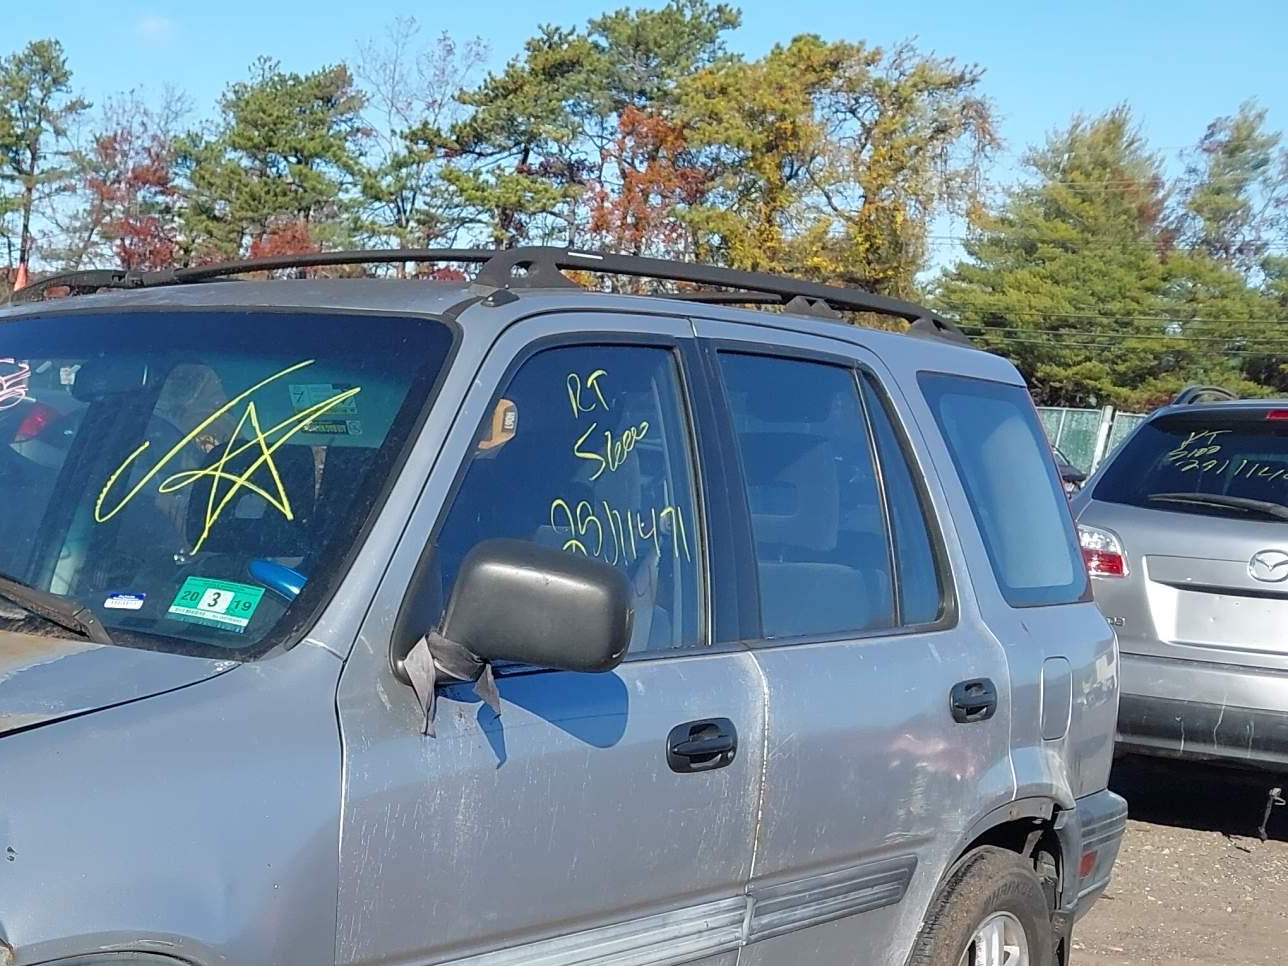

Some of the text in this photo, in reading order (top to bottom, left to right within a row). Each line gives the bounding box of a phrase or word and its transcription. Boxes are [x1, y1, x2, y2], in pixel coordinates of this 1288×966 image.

[567, 369, 610, 419] RT
[181, 590, 253, 612] 20 3 19
